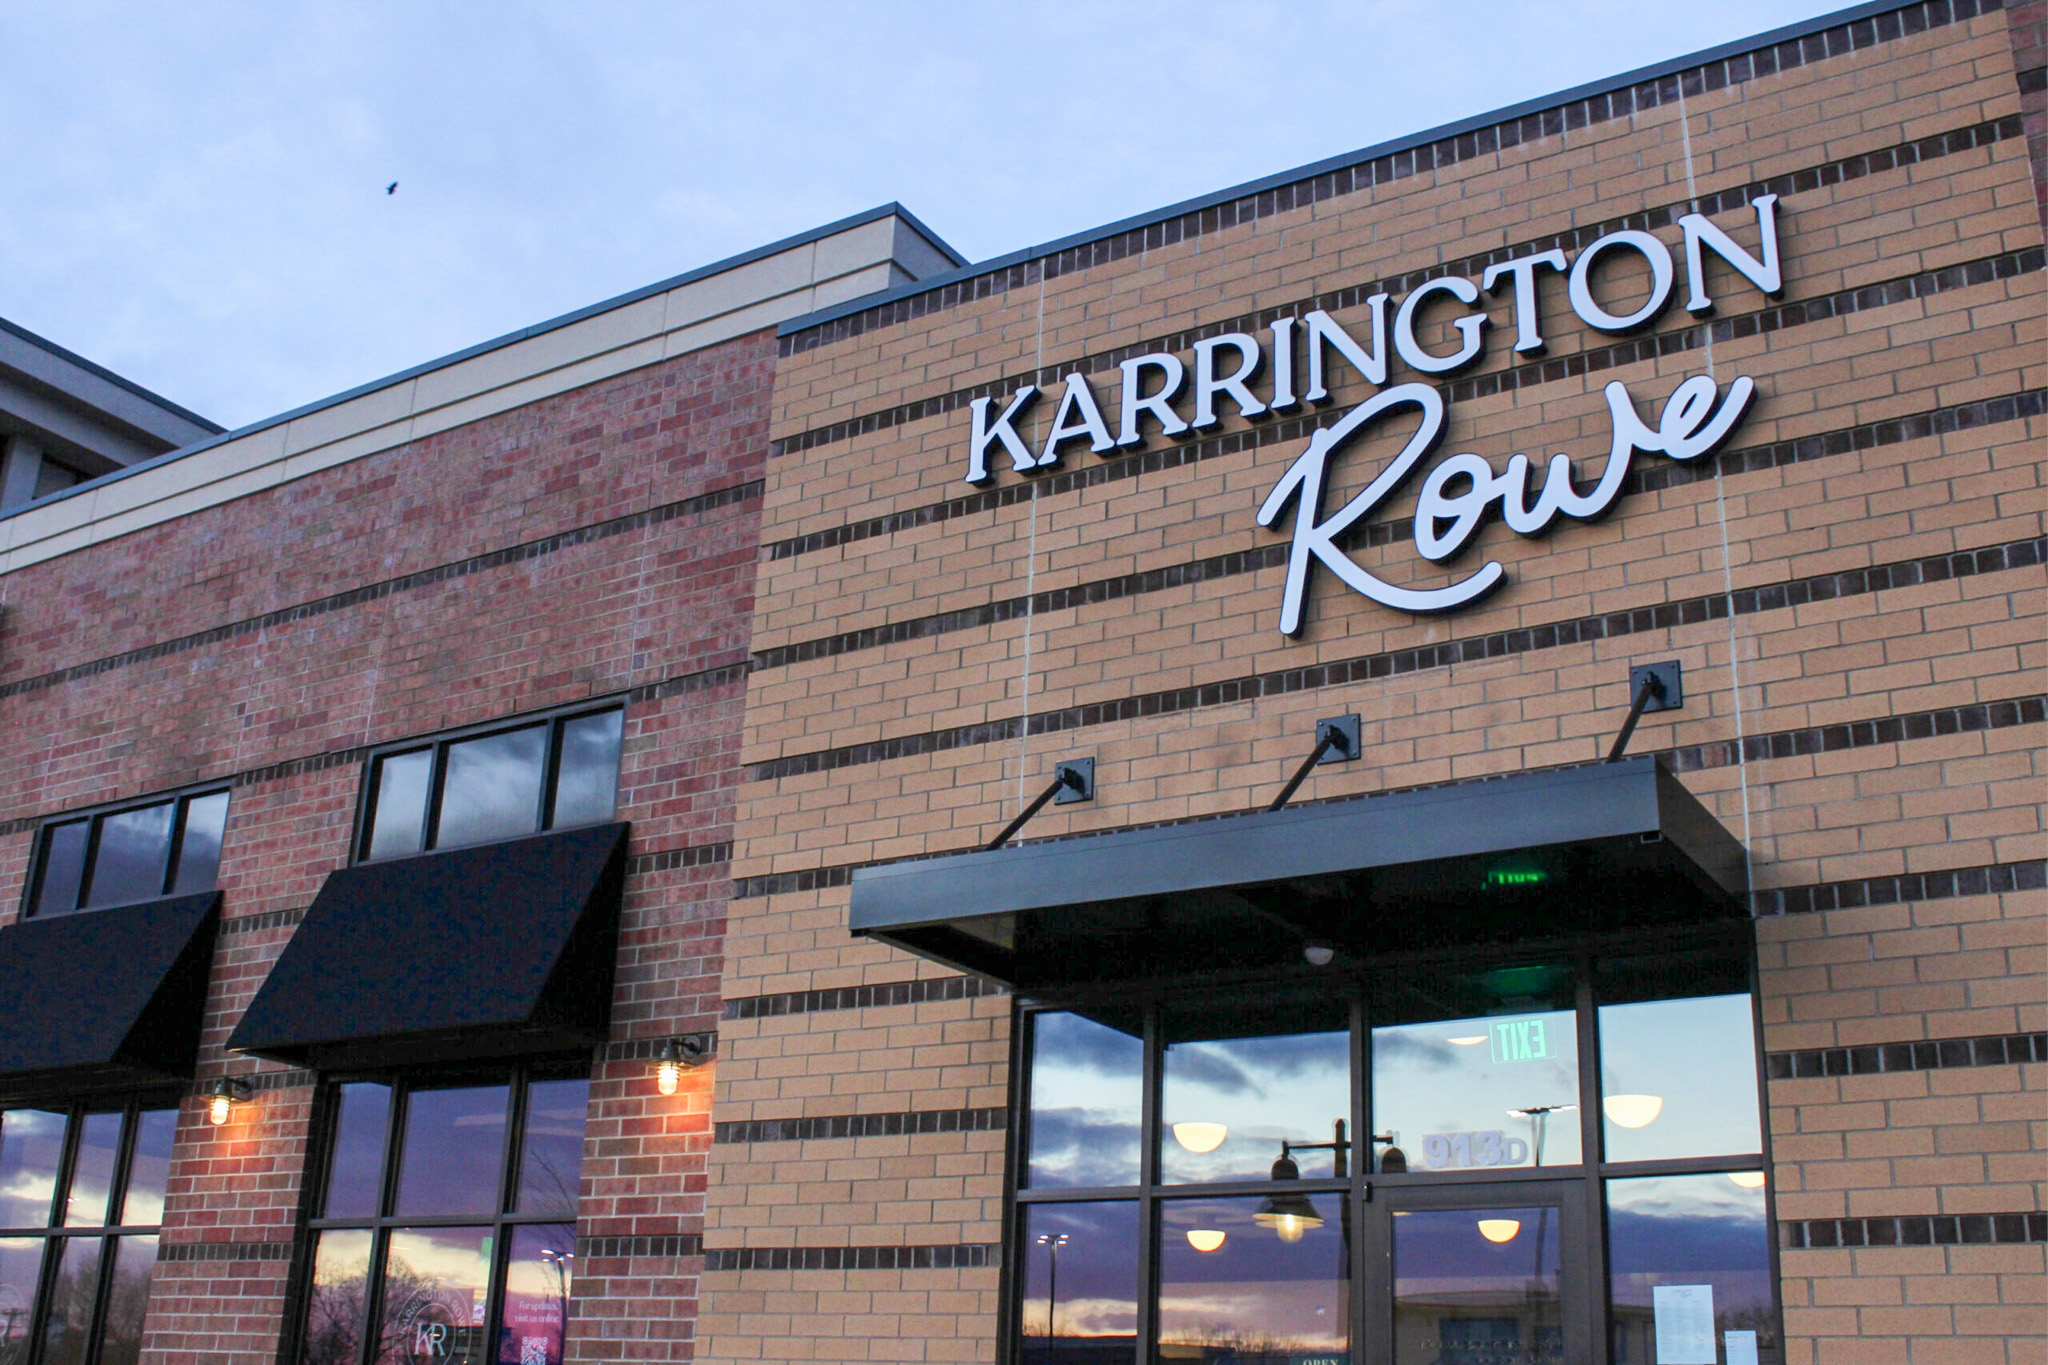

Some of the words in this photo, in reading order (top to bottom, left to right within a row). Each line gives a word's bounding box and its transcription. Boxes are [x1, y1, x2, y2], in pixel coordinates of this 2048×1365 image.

[965, 193, 1784, 485] KARRINGTON
[1256, 375, 1756, 636] Rowe
[399, 1290, 452, 1335] KARRINGTON
[450, 1299, 467, 1337] ROWE
[514, 1313, 528, 1323] visit
[529, 1315, 538, 1323] us
[519, 1300, 530, 1310] For
[414, 1322, 447, 1357] KR
